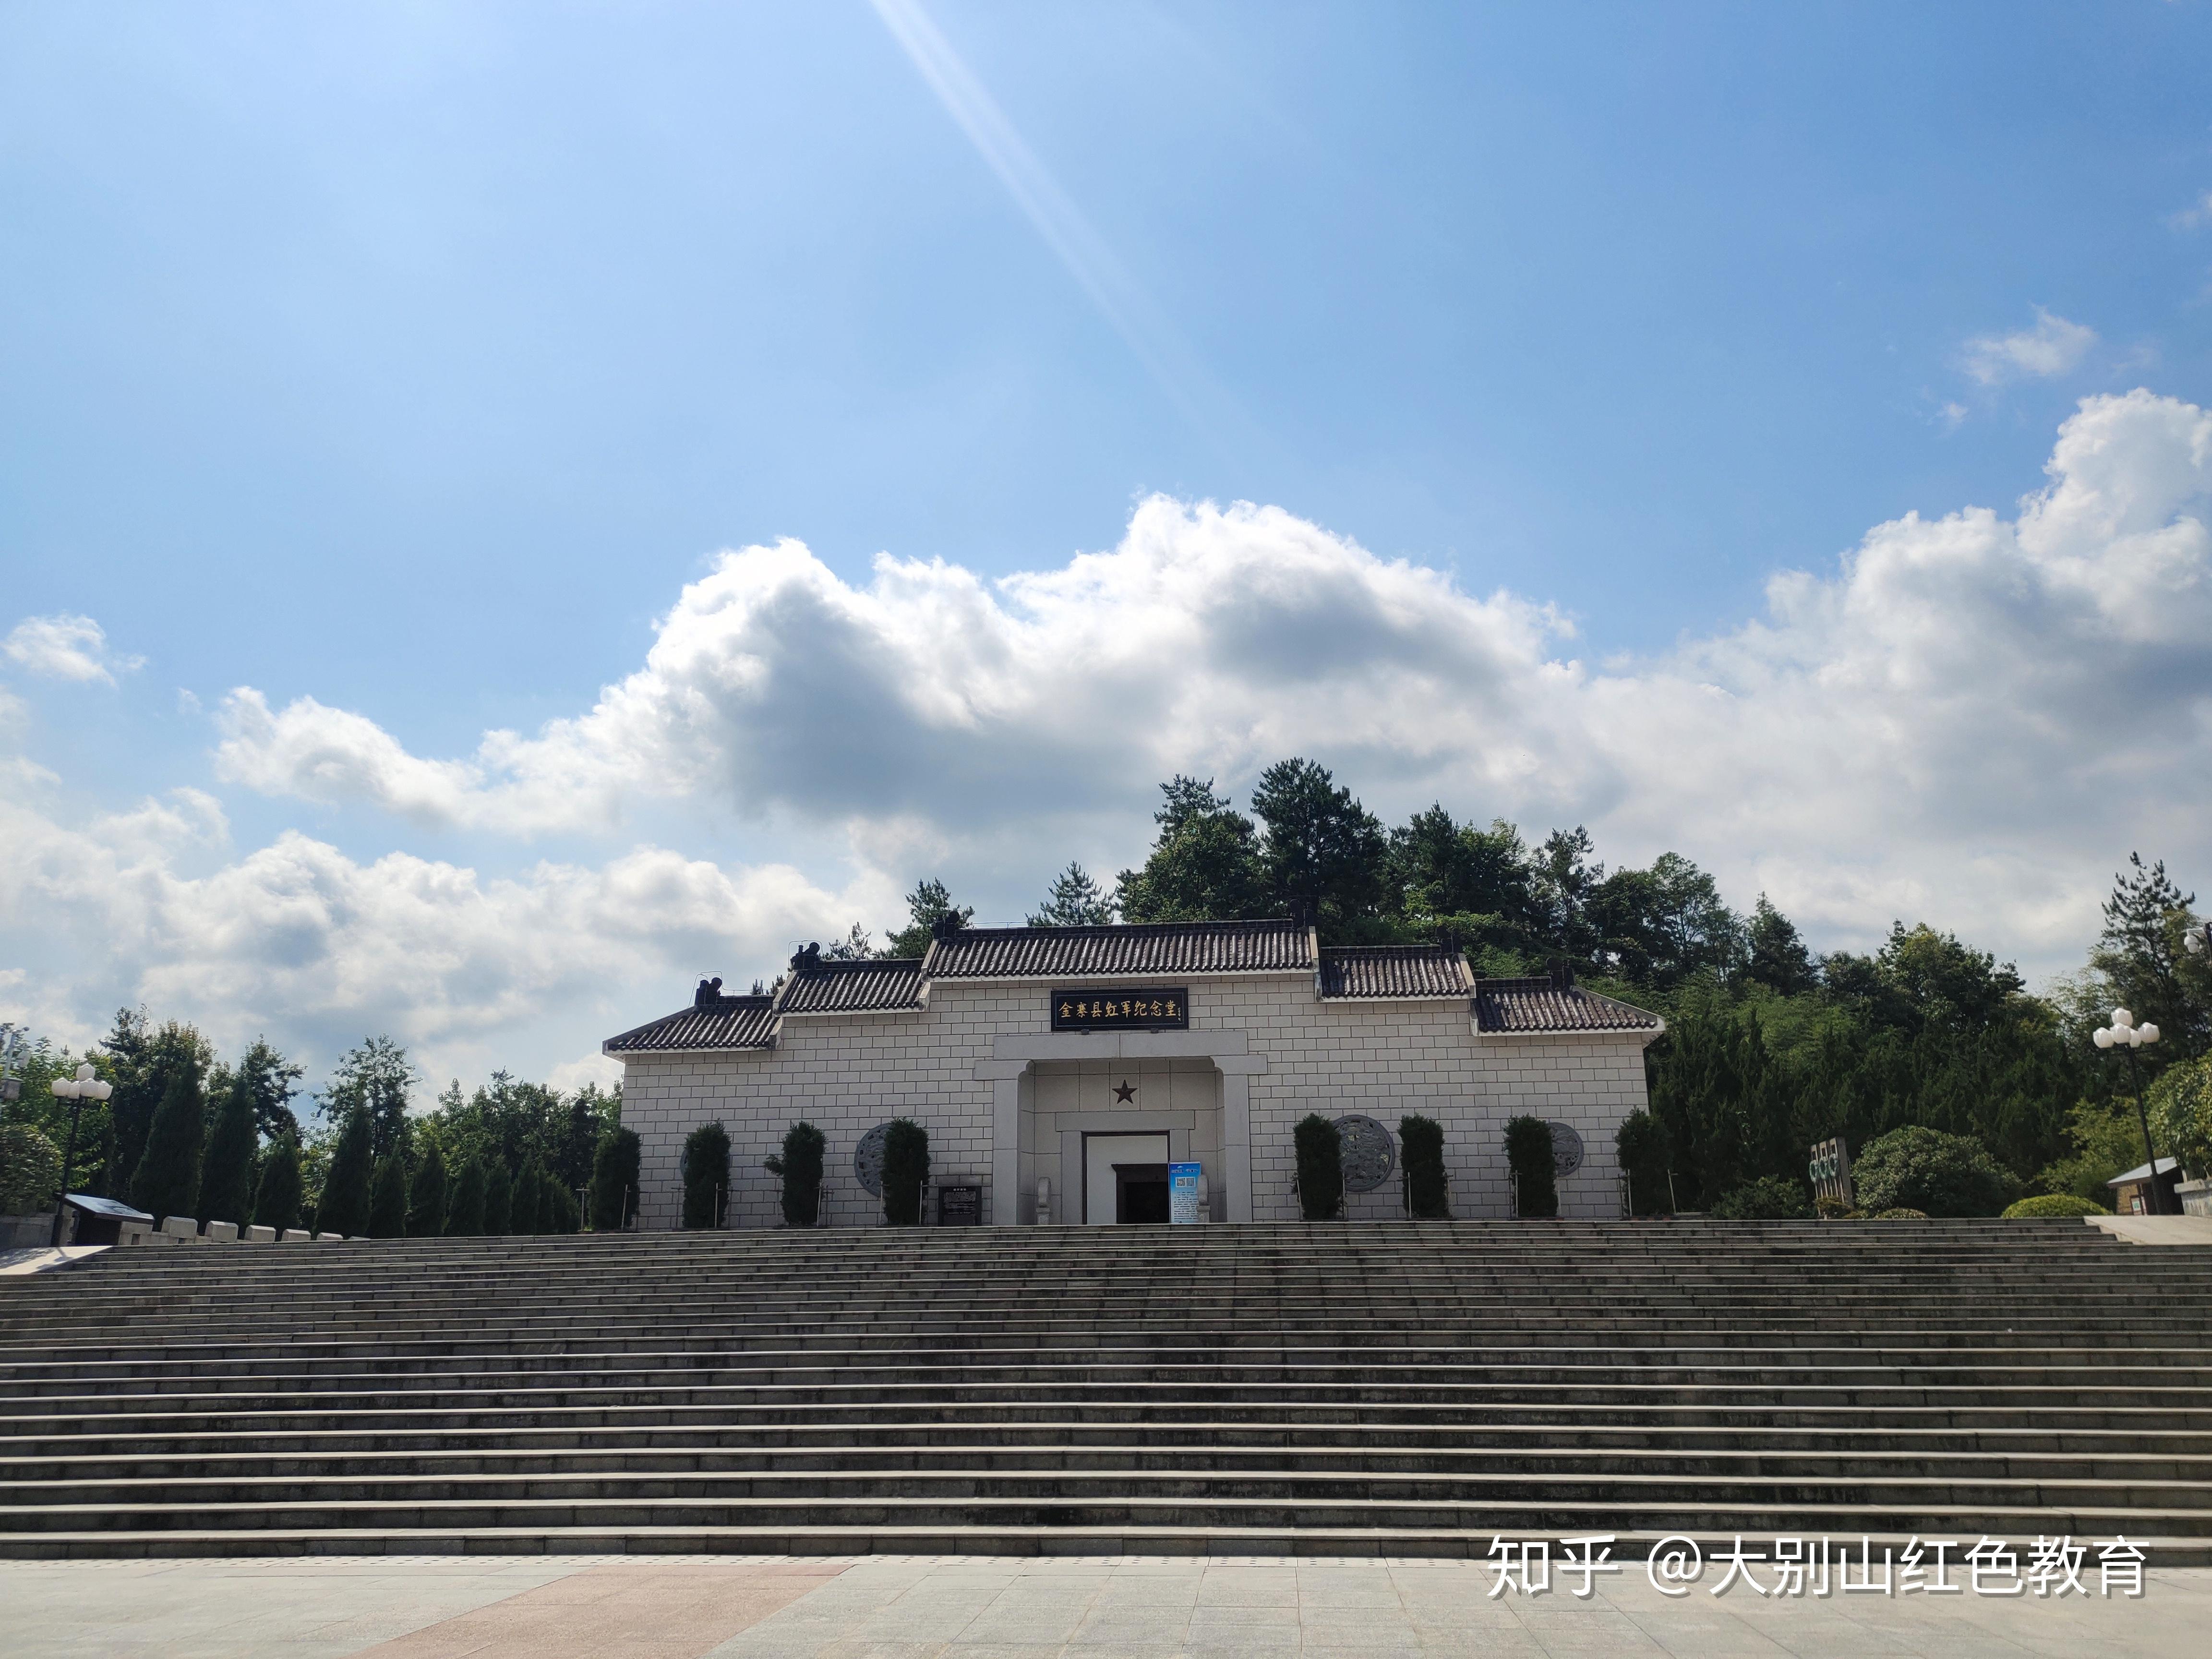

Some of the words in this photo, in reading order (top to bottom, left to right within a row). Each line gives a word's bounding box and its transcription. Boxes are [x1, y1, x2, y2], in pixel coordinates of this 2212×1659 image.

[1058, 1000, 1176, 1018] 金寨县红军纪念堂
